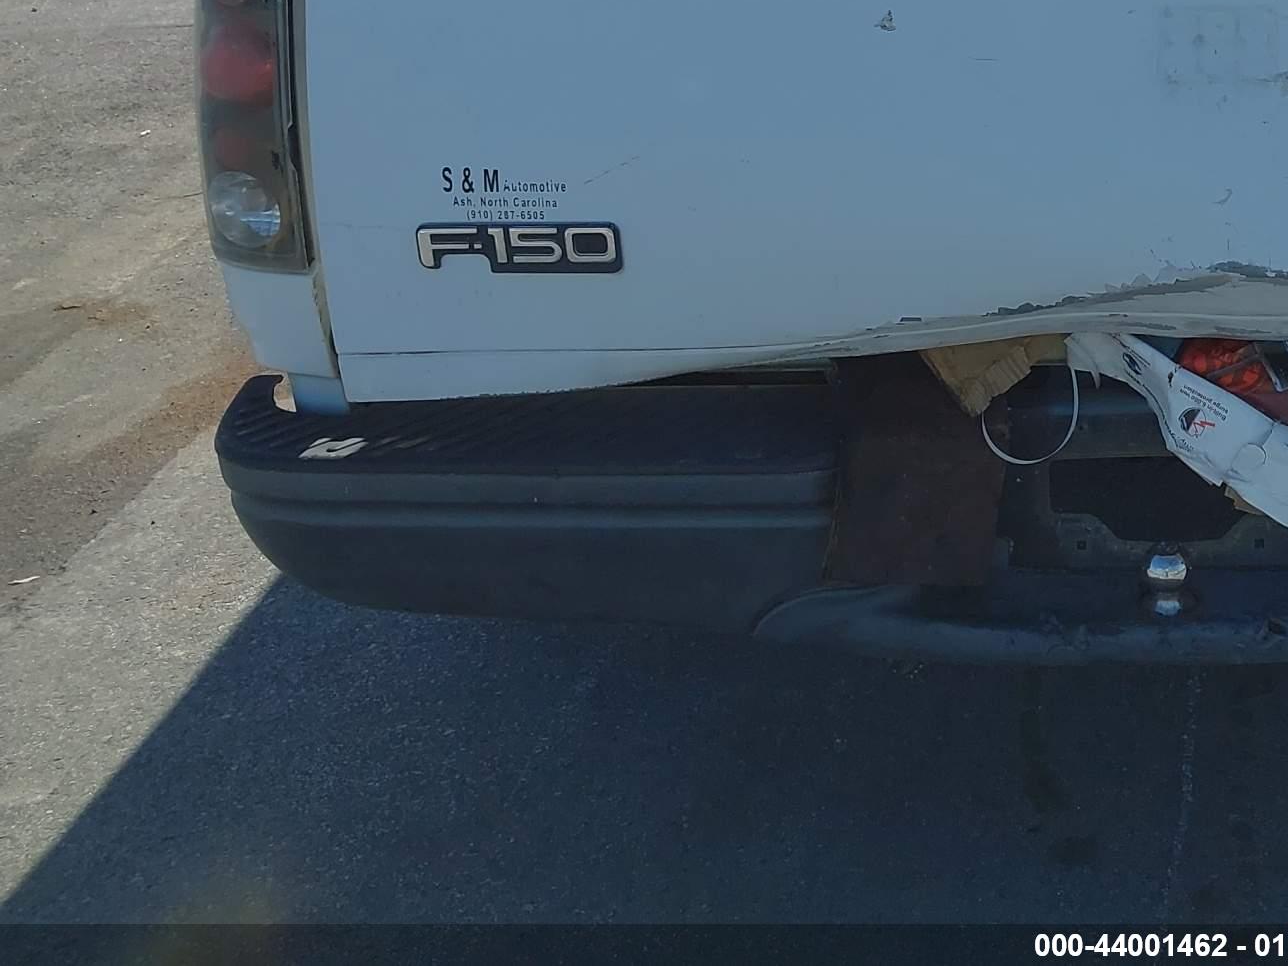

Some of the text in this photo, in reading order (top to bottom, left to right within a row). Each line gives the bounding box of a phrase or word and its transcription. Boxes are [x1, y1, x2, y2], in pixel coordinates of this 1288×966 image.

[442, 166, 567, 193] S & M Automotive
[453, 196, 558, 208] Ash, North Carolina
[466, 209, 493, 221] (910)
[417, 227, 617, 267] F-150
[1183, 385, 1213, 402] protection
